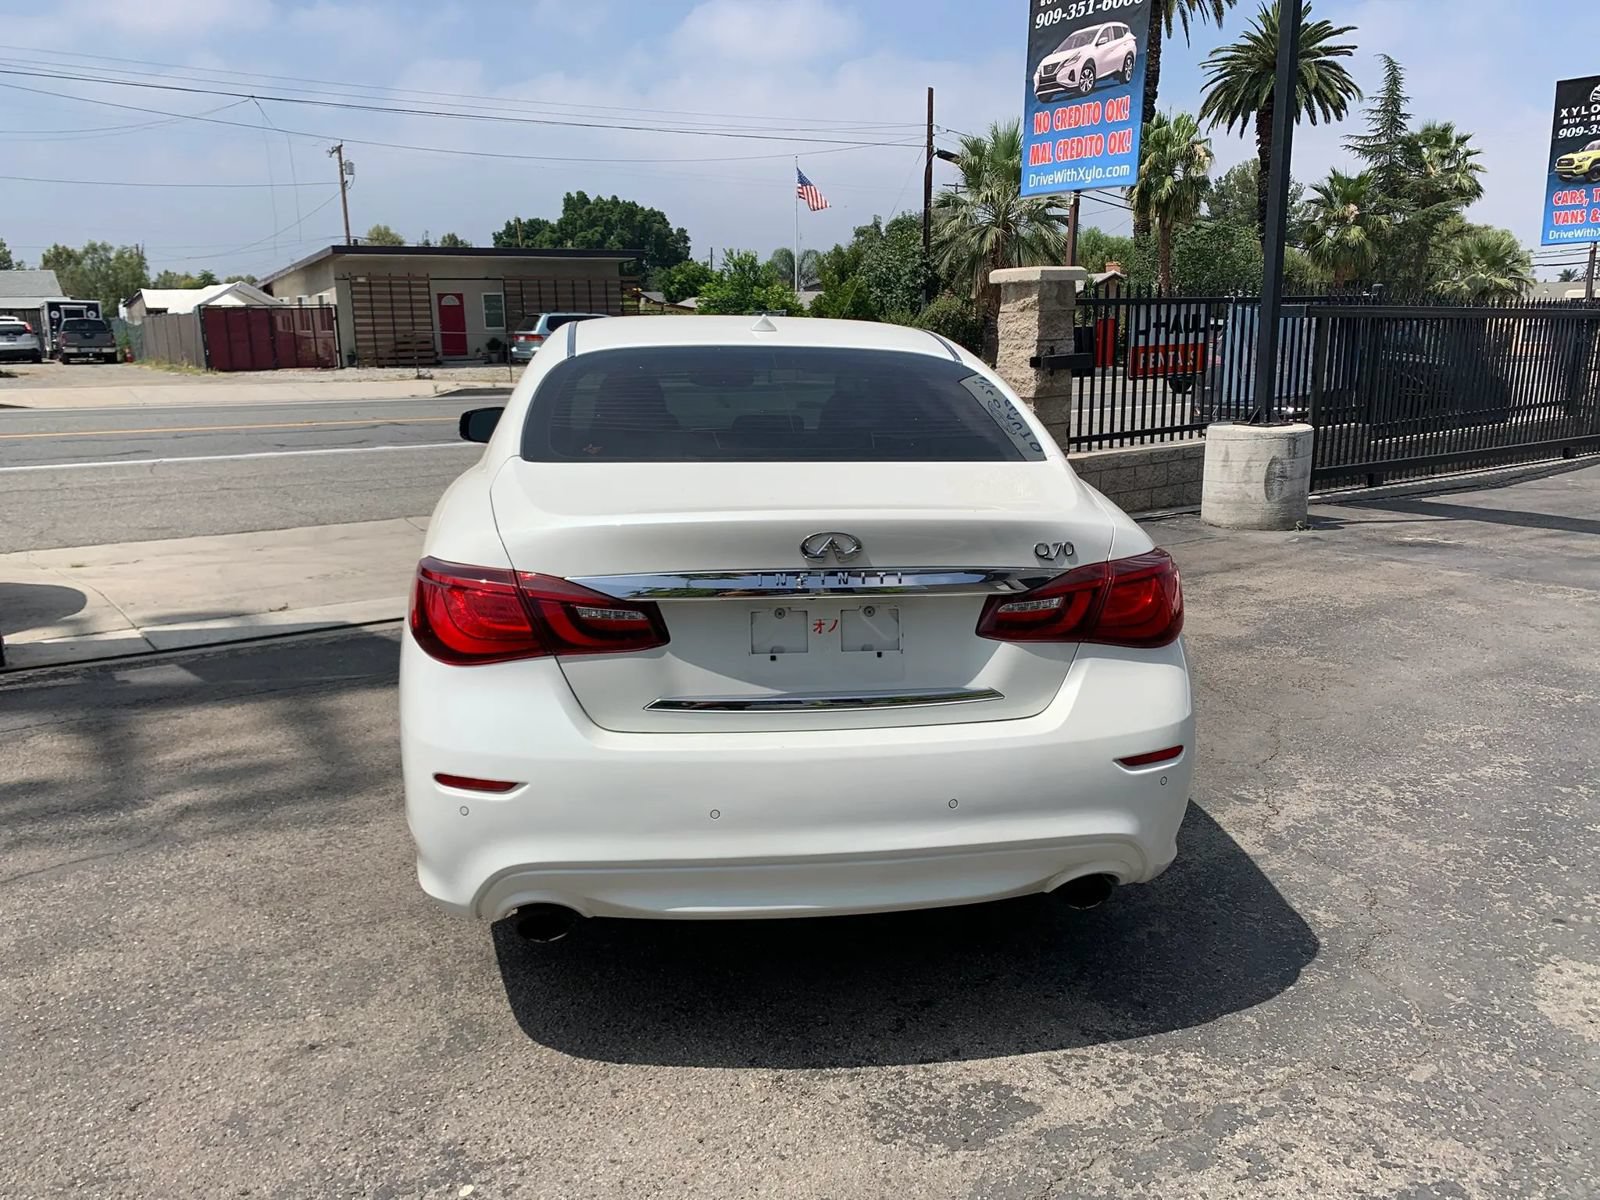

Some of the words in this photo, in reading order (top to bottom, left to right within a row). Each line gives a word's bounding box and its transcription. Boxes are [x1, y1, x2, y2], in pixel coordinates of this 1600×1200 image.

[1034, 111, 1051, 135] NO
[1053, 101, 1102, 131] CREDITO
[1105, 95, 1130, 123] OK!
[1560, 104, 1600, 118] XYLO
[1029, 142, 1053, 166] MAL
[1055, 133, 1104, 163] CREDITO
[1107, 129, 1132, 155] OK!
[1029, 165, 1130, 187] DriveWithXylo.com
[1553, 189, 1589, 206] CARS,
[1553, 209, 1586, 226] VANS
[1034, 541, 1074, 560] Q70
[757, 572, 902, 587] INFINITI
